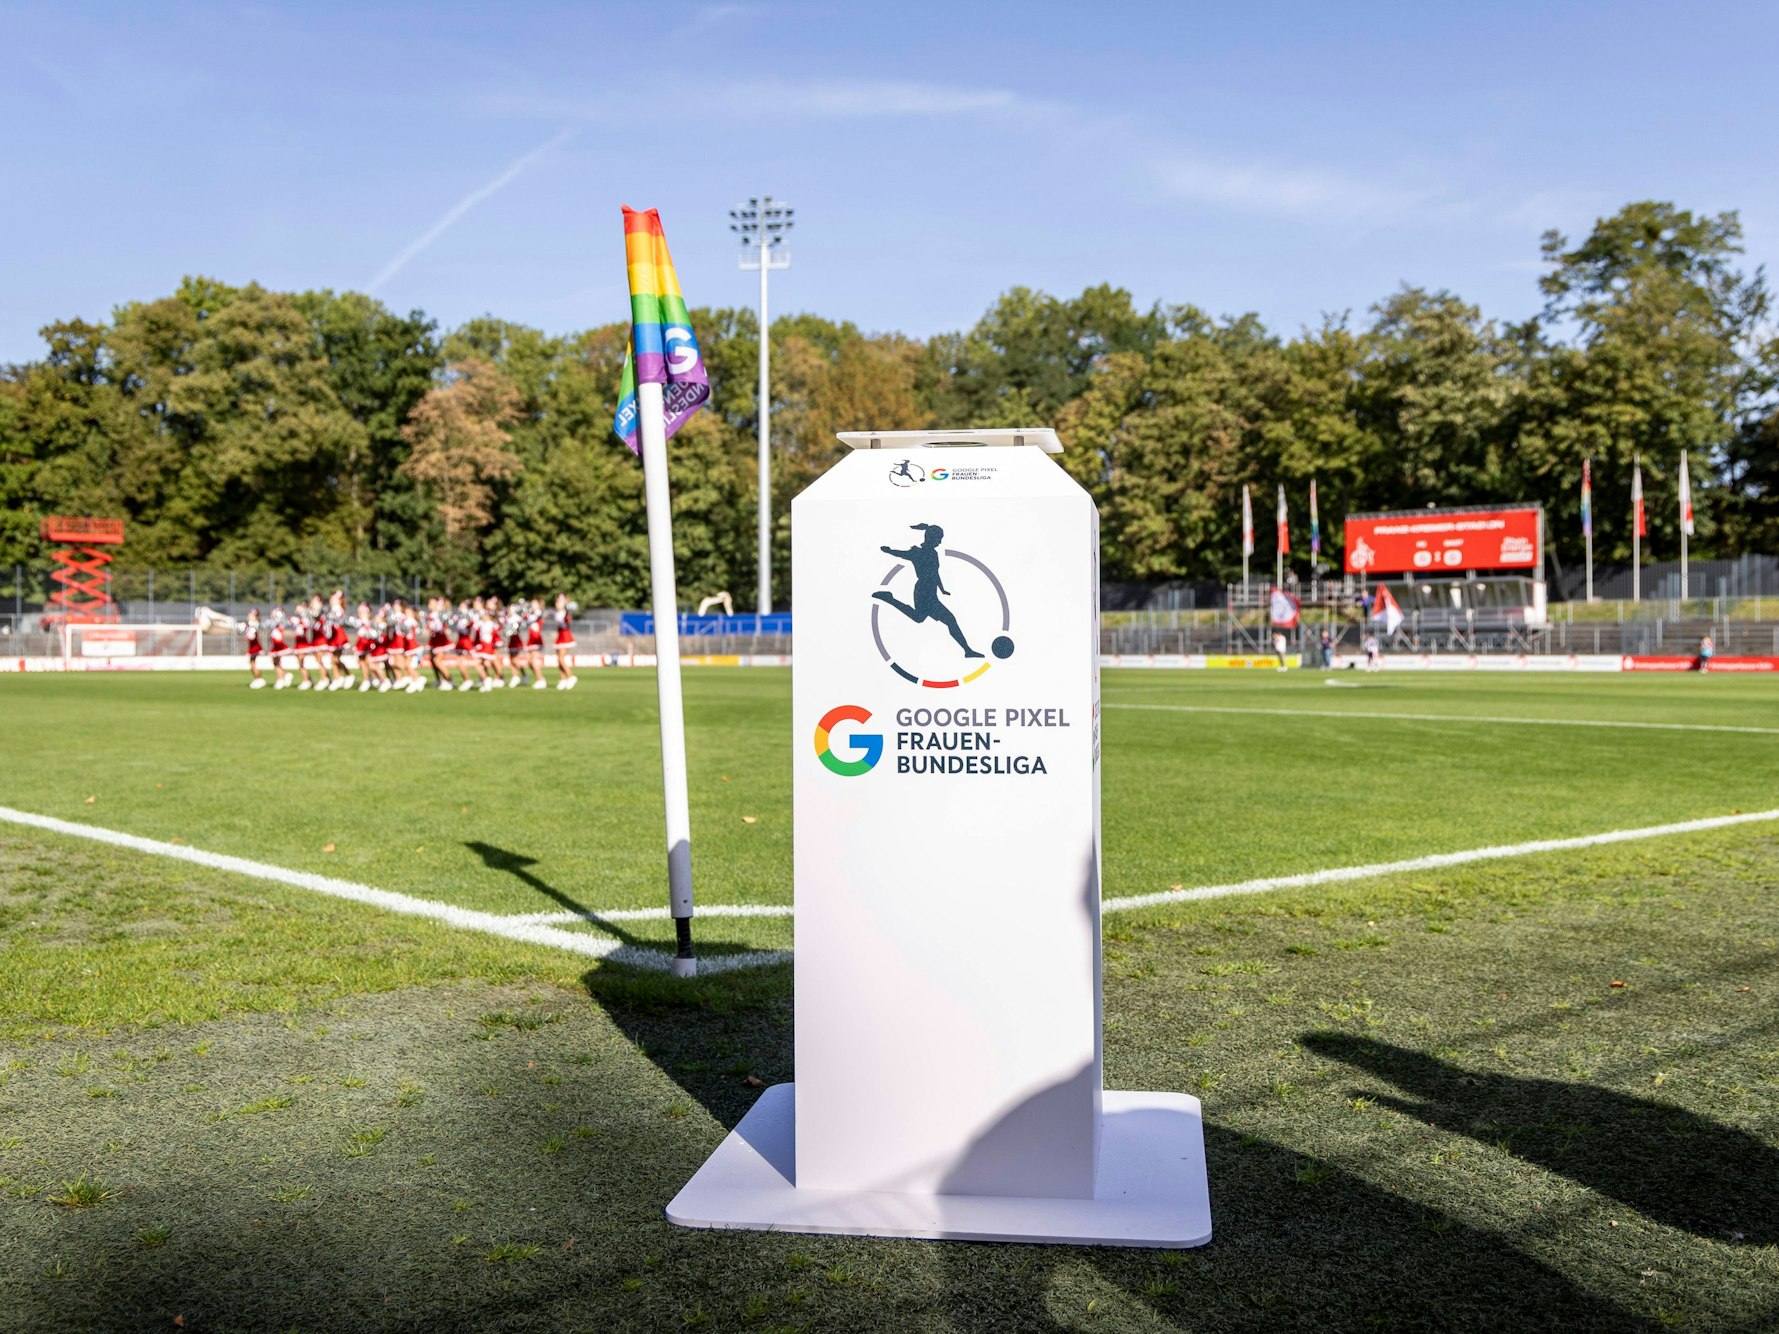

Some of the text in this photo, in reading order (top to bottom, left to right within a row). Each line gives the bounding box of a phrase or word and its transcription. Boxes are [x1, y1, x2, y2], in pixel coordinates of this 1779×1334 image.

[896, 708, 1070, 727] GOOGLE PIXEL
[897, 732, 1001, 750] FRAUEN-
[897, 756, 1048, 774] BUNDESLIGA
